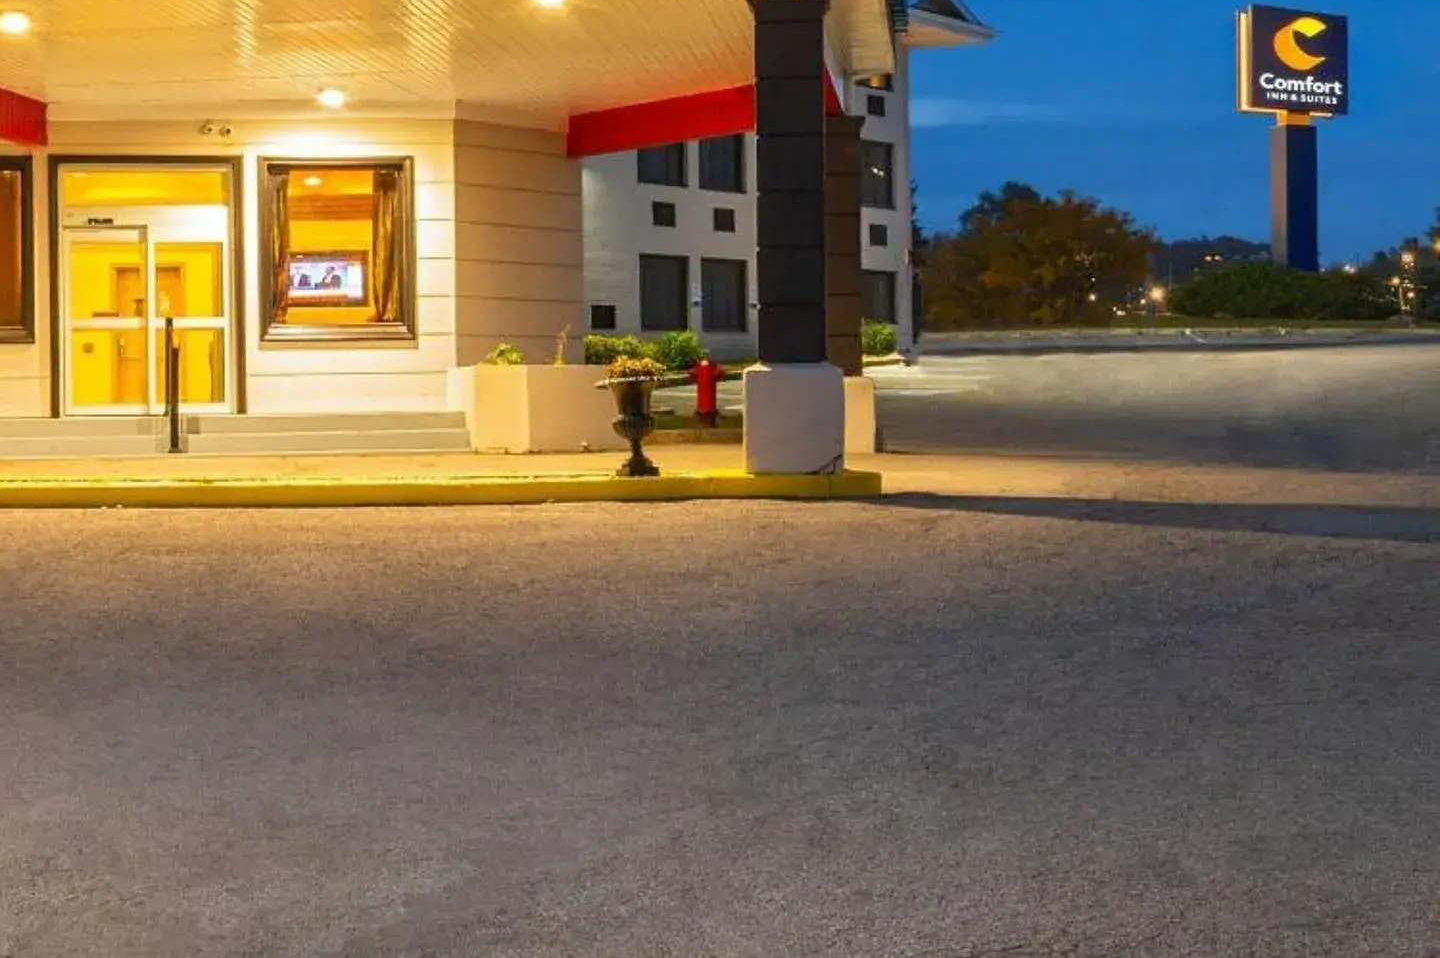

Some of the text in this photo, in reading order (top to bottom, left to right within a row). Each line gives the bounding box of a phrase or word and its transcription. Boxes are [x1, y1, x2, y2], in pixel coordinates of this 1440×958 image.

[1259, 72, 1343, 95] Comfort
[1266, 91, 1288, 101] INN
[1300, 93, 1338, 105] SUITES
